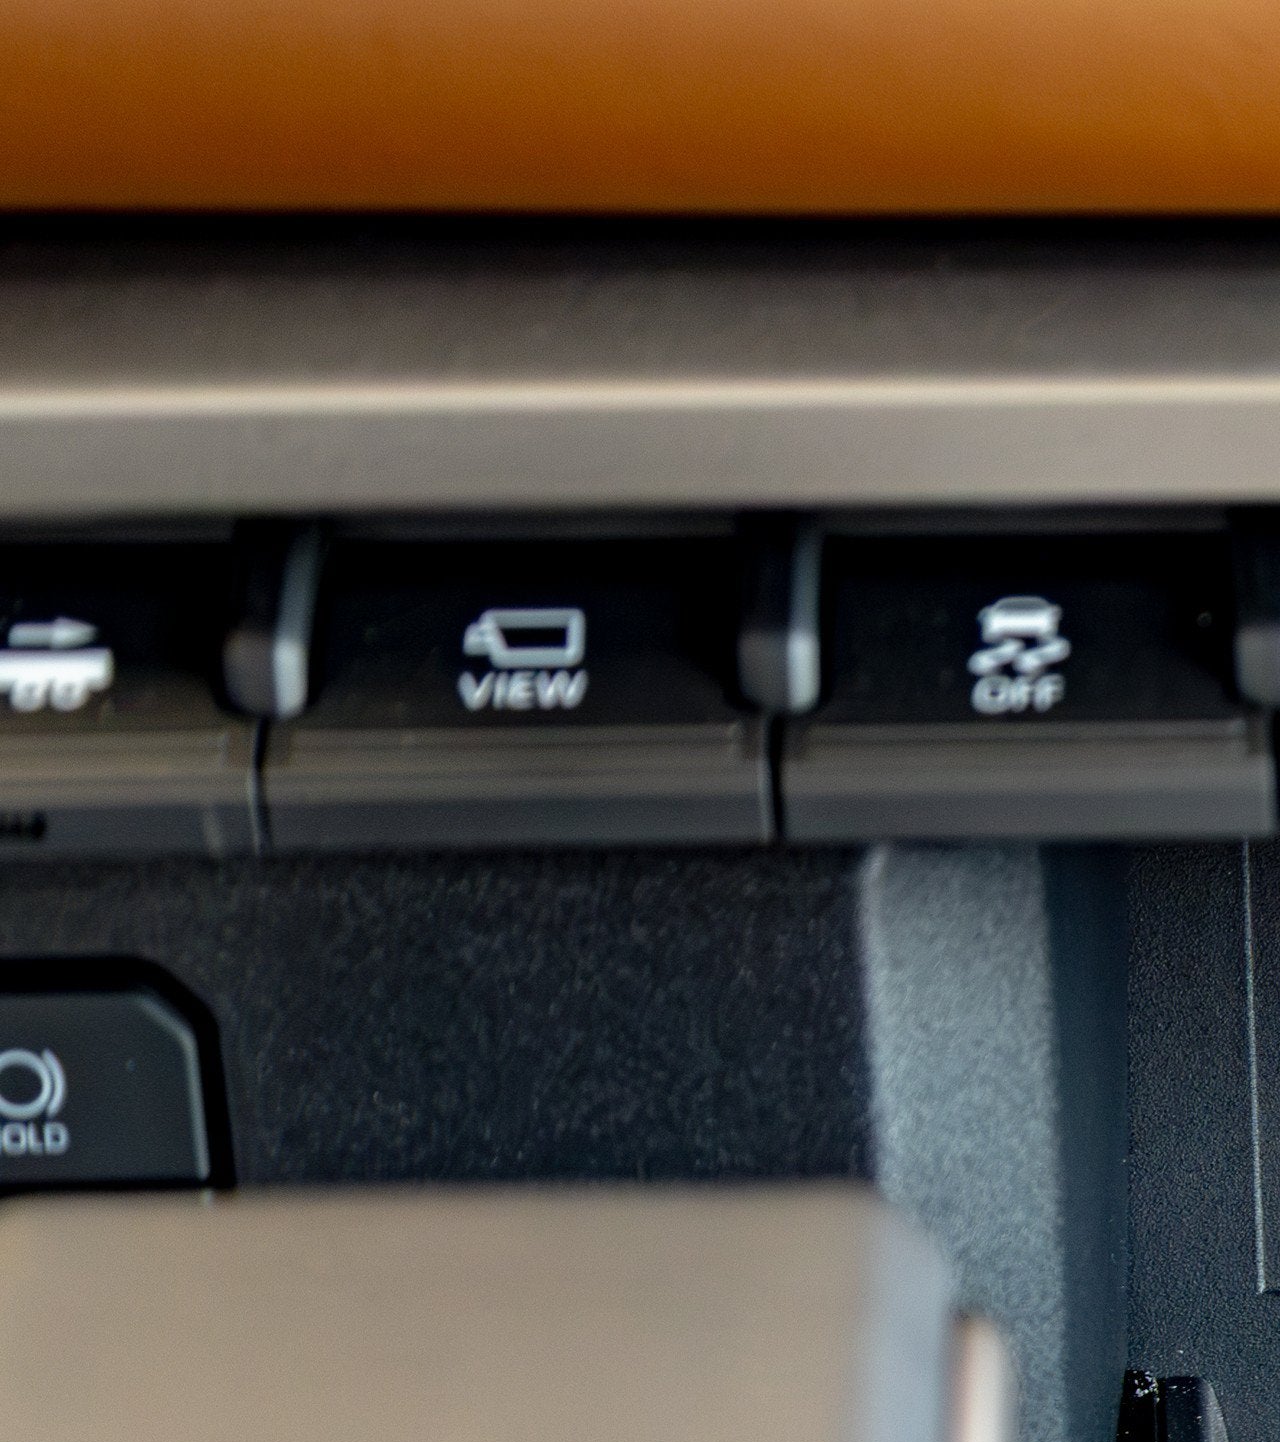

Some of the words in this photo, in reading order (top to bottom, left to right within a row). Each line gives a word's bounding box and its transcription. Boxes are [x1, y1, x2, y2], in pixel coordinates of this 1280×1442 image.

[458, 669, 588, 711] VIEW
[971, 674, 1065, 714] OFF
[0, 1121, 69, 1155] OLD
